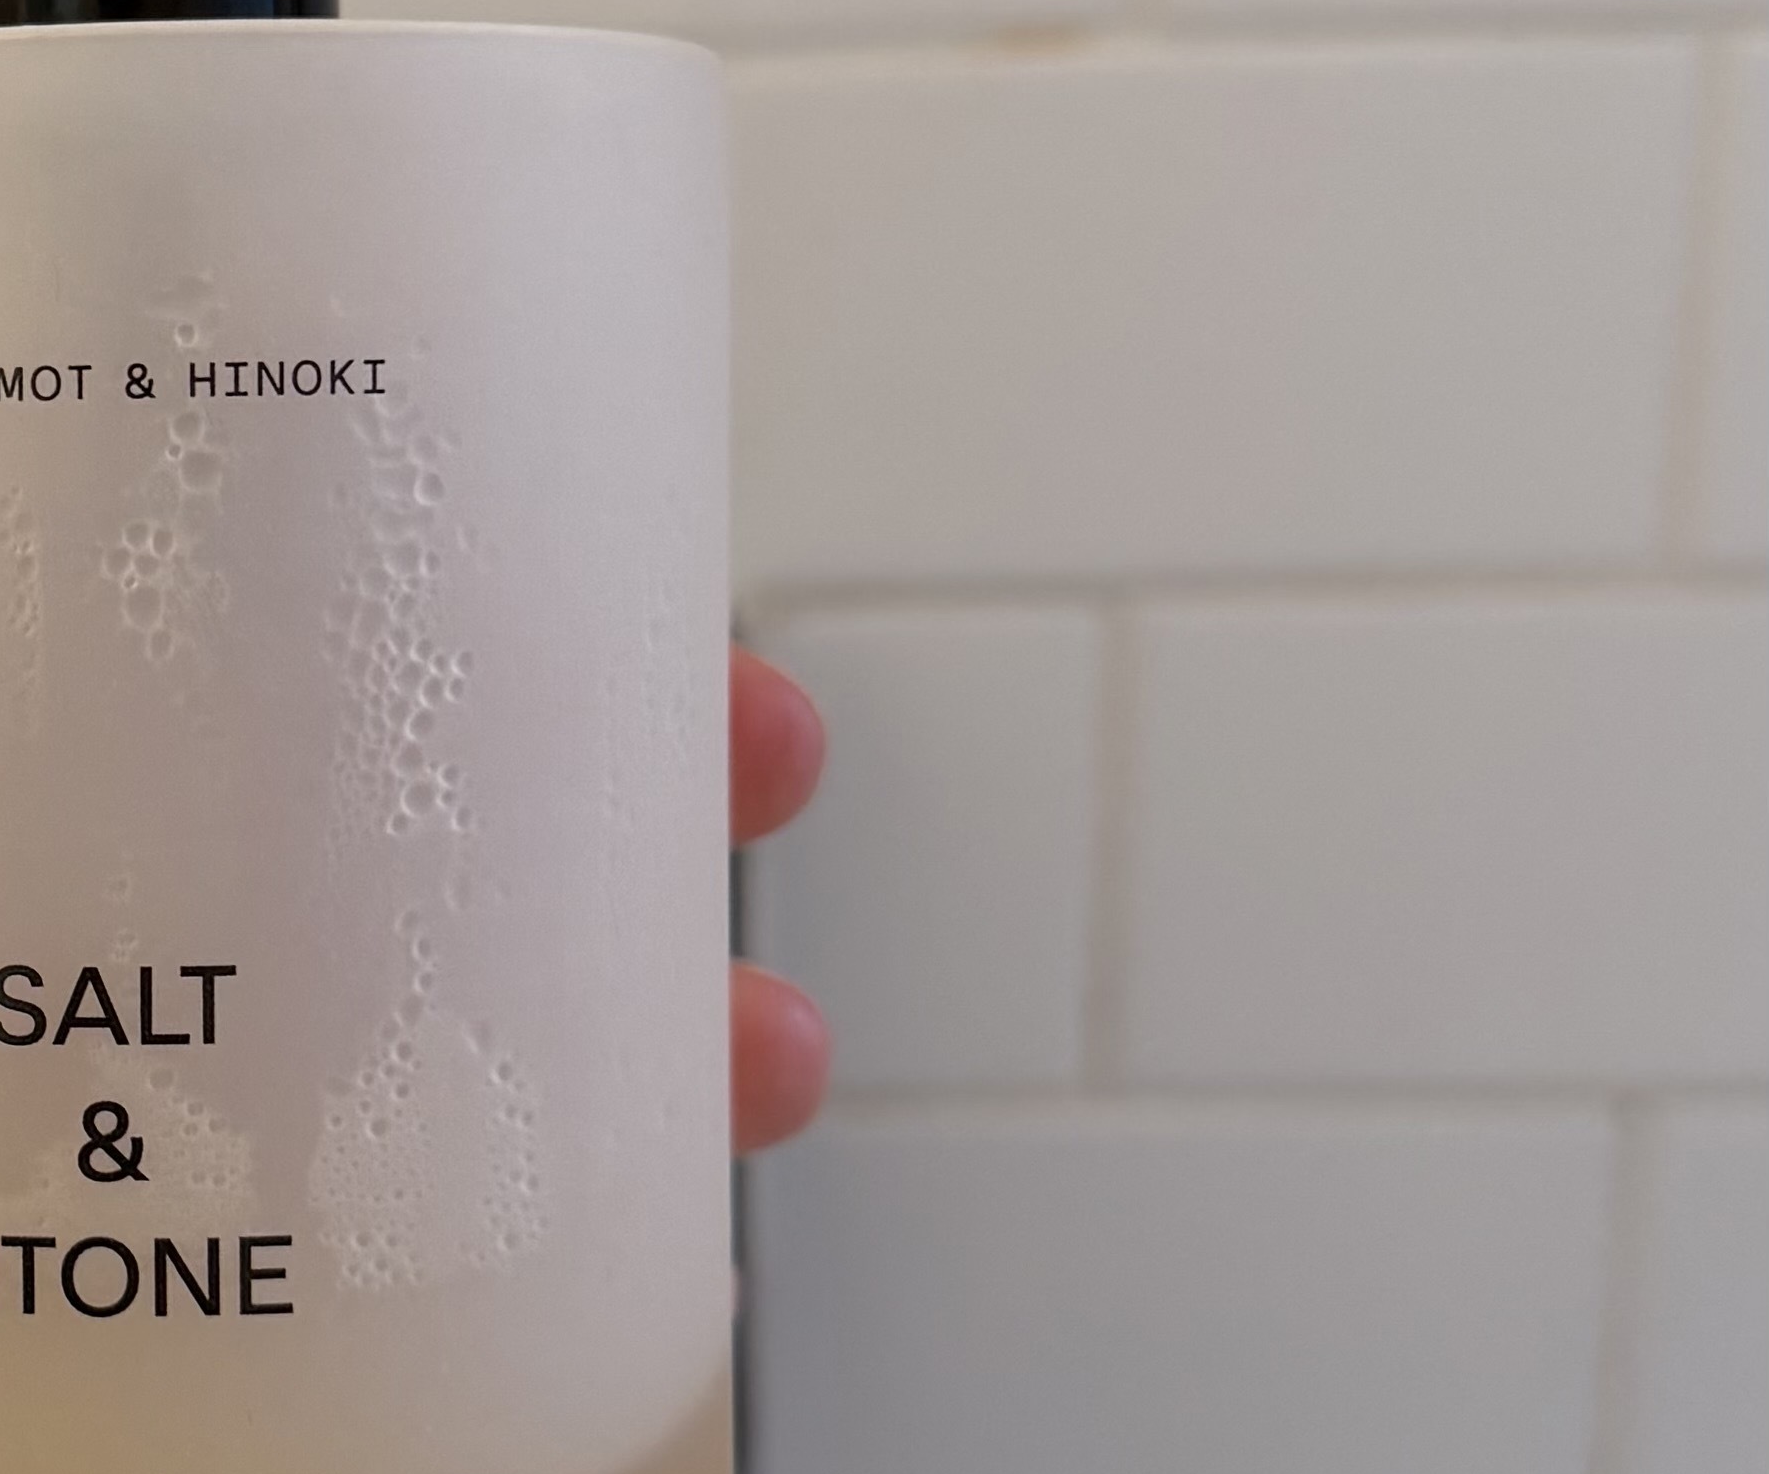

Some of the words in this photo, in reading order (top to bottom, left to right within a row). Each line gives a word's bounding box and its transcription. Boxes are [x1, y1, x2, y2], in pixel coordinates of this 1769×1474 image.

[124, 362, 158, 400] &
[188, 358, 387, 399] HINOKI
[77, 1099, 151, 1184] &
